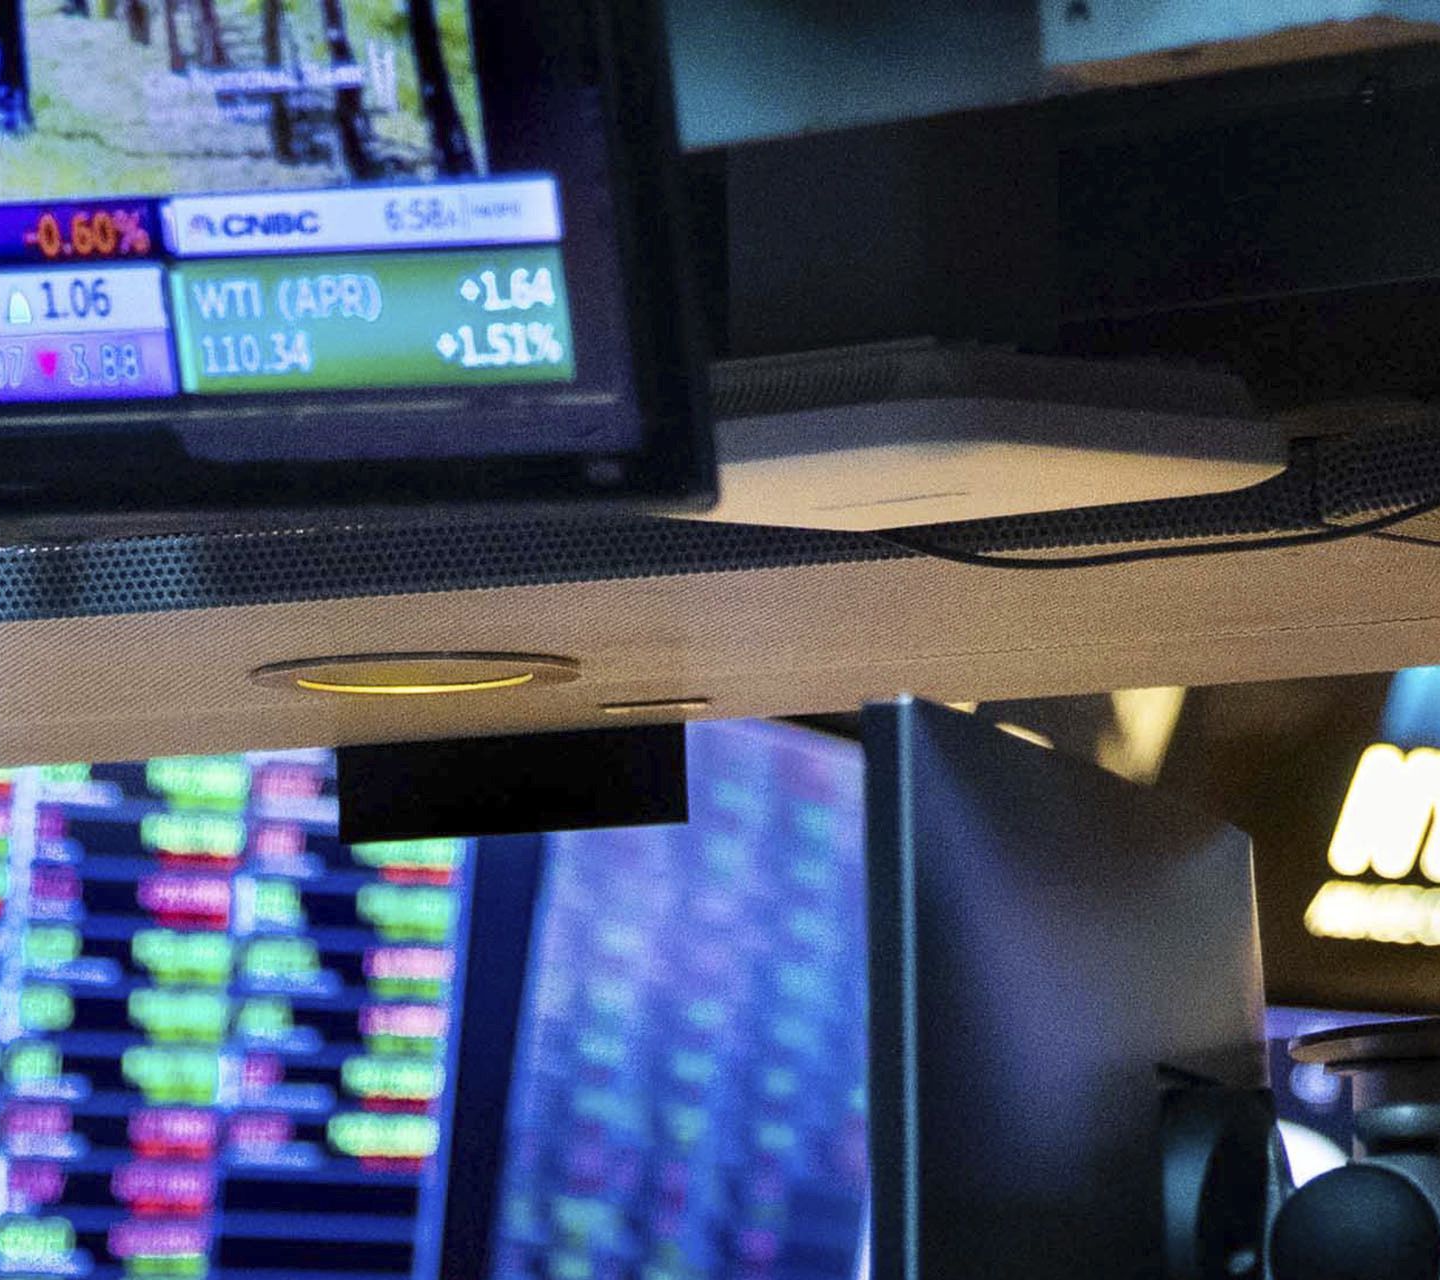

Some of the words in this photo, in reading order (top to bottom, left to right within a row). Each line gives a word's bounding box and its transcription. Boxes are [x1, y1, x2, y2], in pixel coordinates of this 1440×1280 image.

[23, 209, 150, 260] -0.60%
[222, 210, 320, 238] CNBC
[40, 278, 111, 320] 1.06
[192, 281, 263, 323] WTI
[276, 272, 384, 323] (APR)
[199, 332, 313, 379] 110.34
